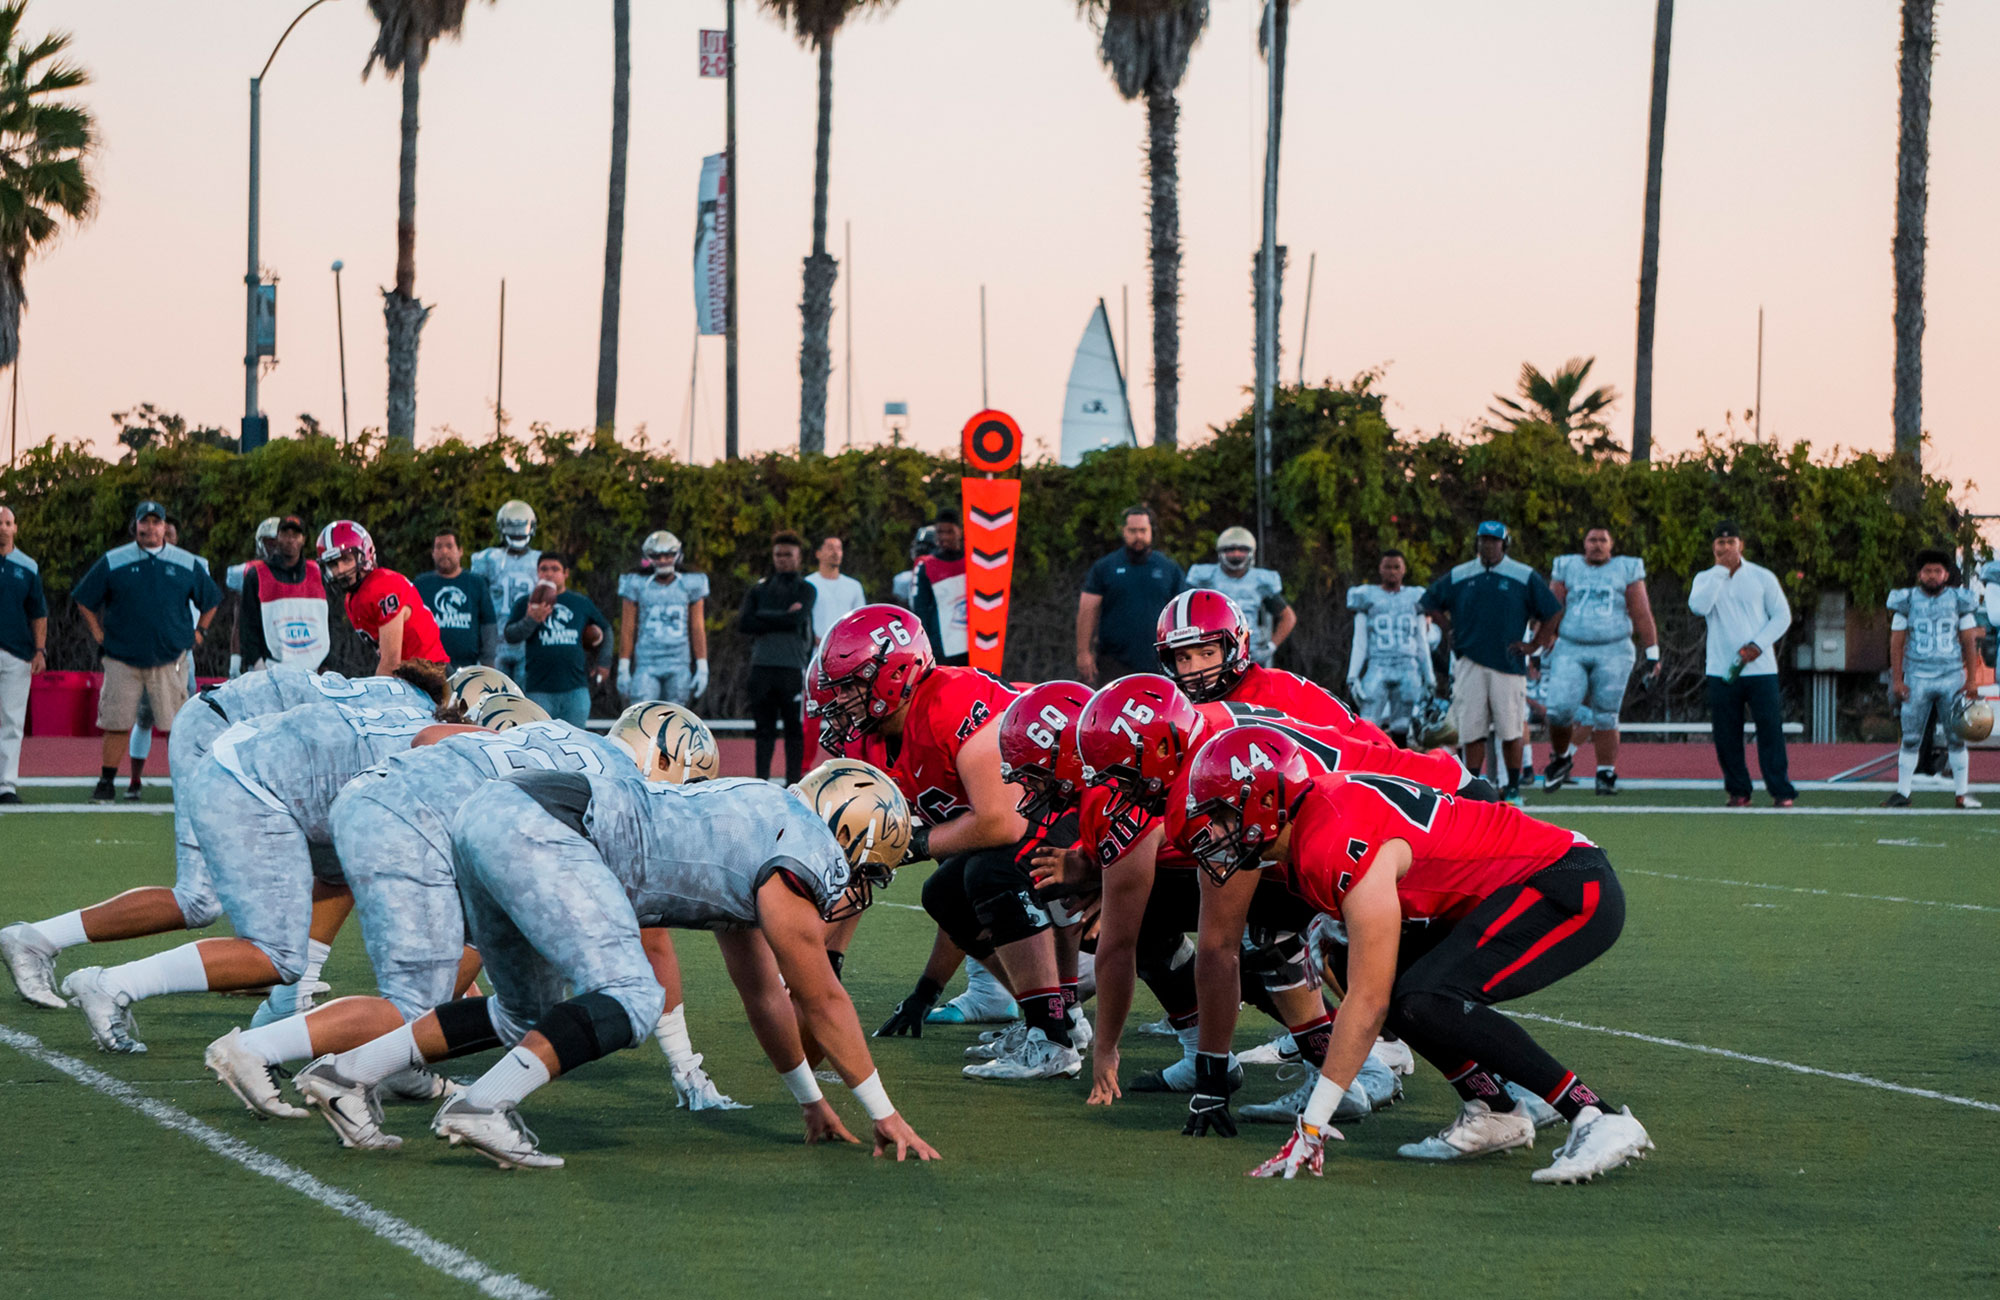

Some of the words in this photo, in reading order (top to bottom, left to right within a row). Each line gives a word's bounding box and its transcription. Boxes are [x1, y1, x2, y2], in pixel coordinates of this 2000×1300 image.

[378, 593, 399, 617] 19
[1572, 584, 1615, 617] 73
[645, 604, 685, 638] 43
[869, 619, 912, 656] 56
[1026, 704, 1069, 750] 60
[1109, 697, 1155, 746] 75
[1230, 742, 1274, 782] 44
